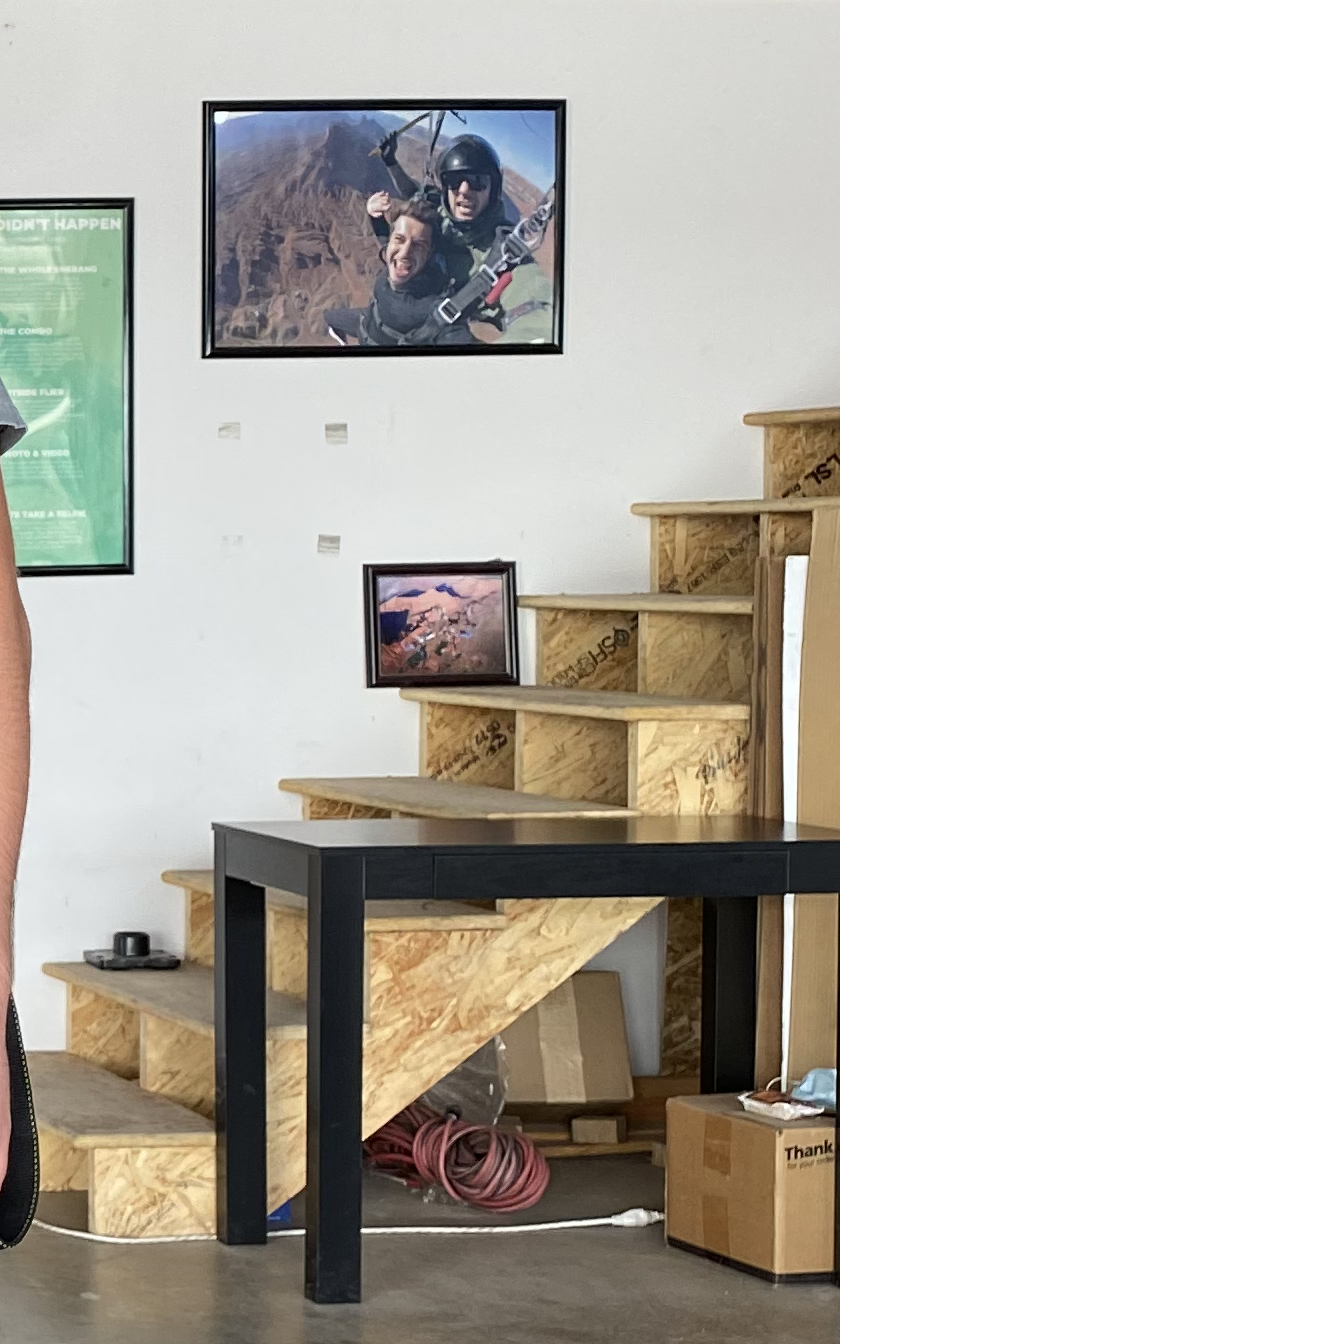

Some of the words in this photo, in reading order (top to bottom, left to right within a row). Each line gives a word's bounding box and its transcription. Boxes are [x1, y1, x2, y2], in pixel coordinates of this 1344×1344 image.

[55, 217, 123, 231] HAPPEN
[0, 327, 16, 335] THE
[18, 327, 53, 335] COMBO
[785, 1139, 834, 1161] Thank
